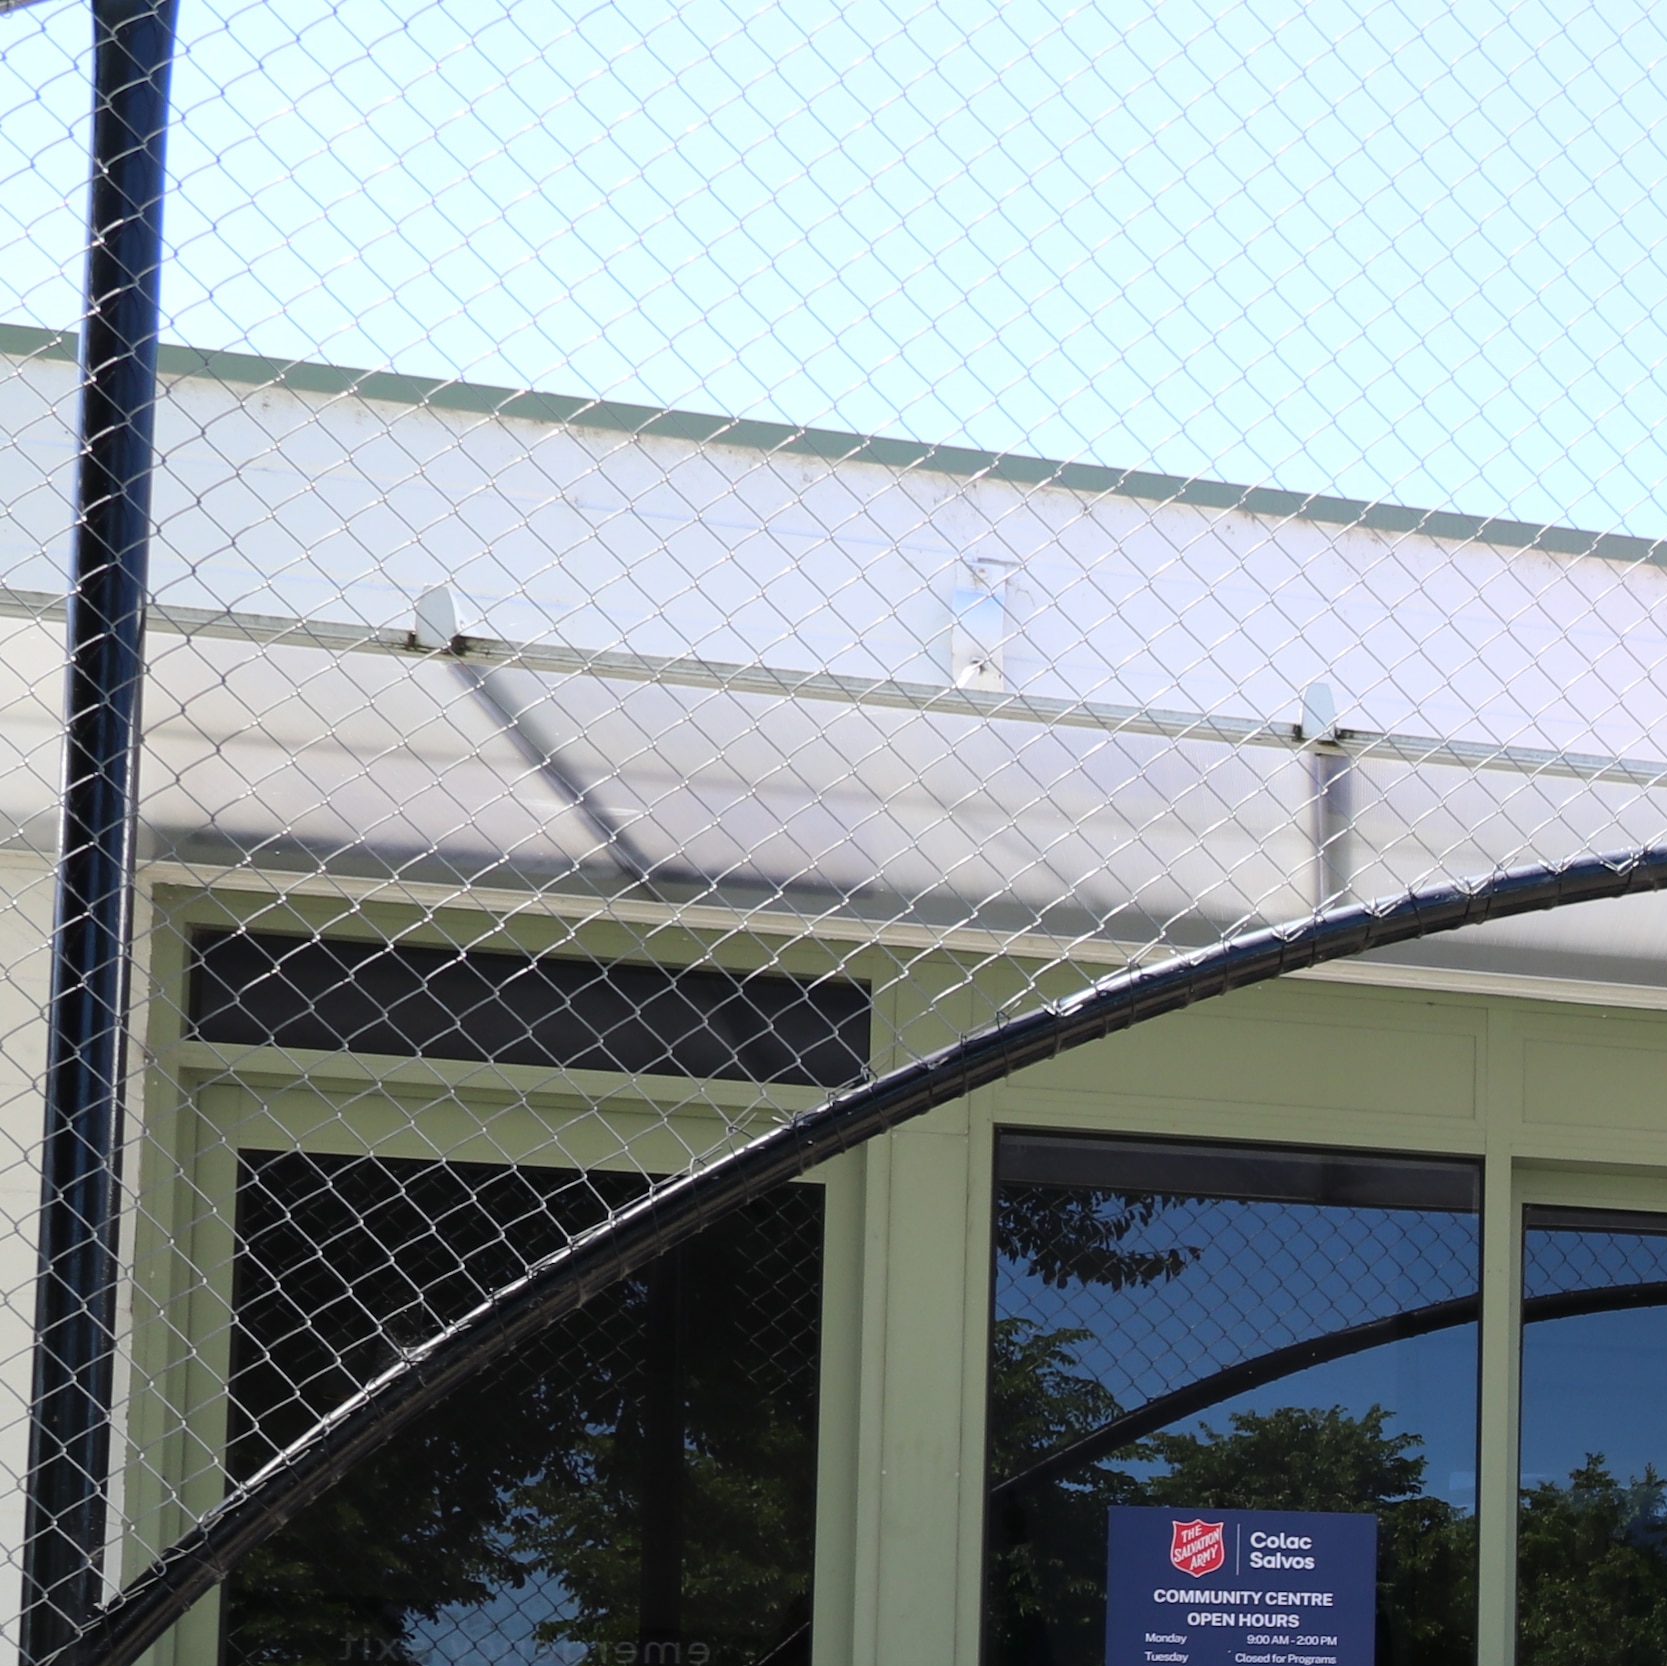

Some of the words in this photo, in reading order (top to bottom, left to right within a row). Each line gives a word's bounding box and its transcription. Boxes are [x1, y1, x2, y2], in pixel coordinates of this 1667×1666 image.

[1181, 1525, 1202, 1543] THE
[1250, 1532, 1312, 1549] Colac
[1174, 1528, 1220, 1562] SALVATION
[1190, 1545, 1218, 1570] ARMY
[1250, 1552, 1314, 1569] Salvos
[1154, 1590, 1262, 1605] COMMUNITY
[1265, 1592, 1333, 1606] CENTRE
[1187, 1612, 1234, 1626] OPEN
[1239, 1614, 1299, 1628] HOURS
[1145, 1633, 1187, 1644] Monday
[1247, 1635, 1270, 1645] 9:00
[1272, 1635, 1289, 1645] AM
[1297, 1636, 1318, 1645] 2:00
[1320, 1636, 1337, 1646] PM
[1145, 1652, 1188, 1664] Tuesday
[1235, 1653, 1270, 1663] Closed
[1272, 1653, 1286, 1663] for
[1288, 1654, 1336, 1665] Programs
